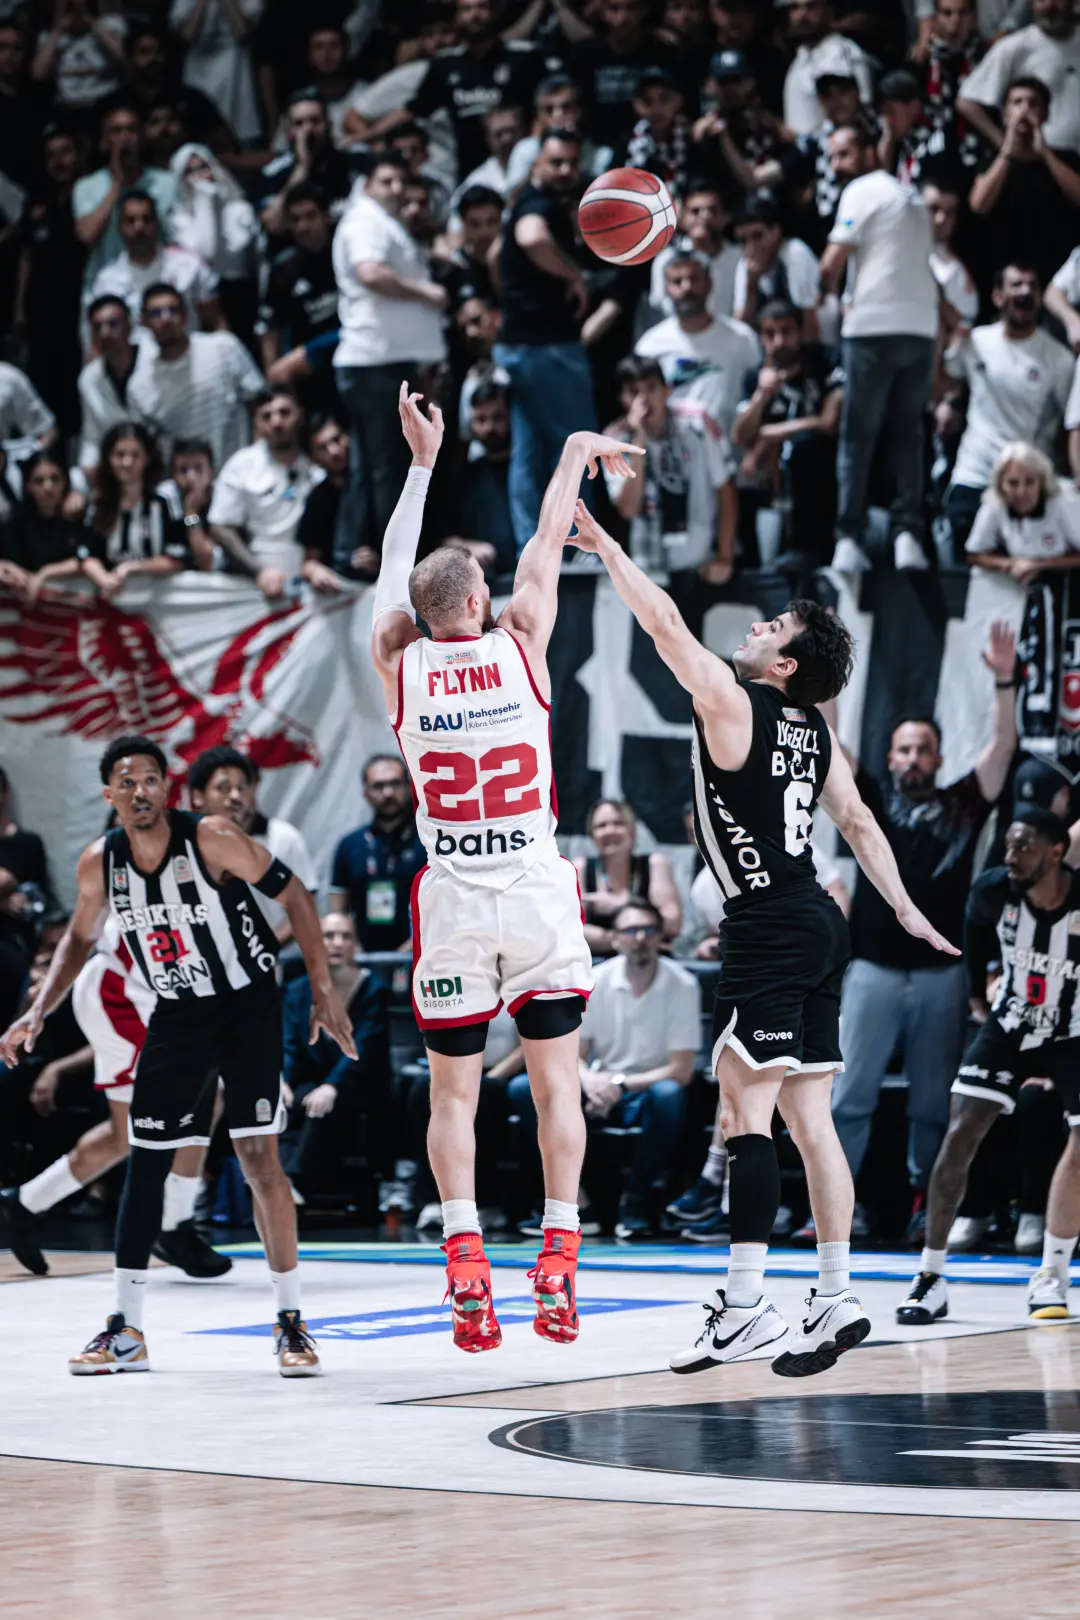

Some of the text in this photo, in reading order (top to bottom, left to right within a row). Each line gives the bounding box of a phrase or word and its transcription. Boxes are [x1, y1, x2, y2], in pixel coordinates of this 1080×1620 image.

[427, 662, 502, 697] FLYNN
[419, 702, 521, 731] BAU Bahçeşehir
[468, 720, 488, 729] Kıbrıs
[419, 742, 543, 822] 22
[784, 781, 813, 857] 6
[146, 929, 191, 963] 21
[420, 976, 463, 998] HDI
[1026, 975, 1047, 1006] 0
[753, 1030, 793, 1041] Govee
